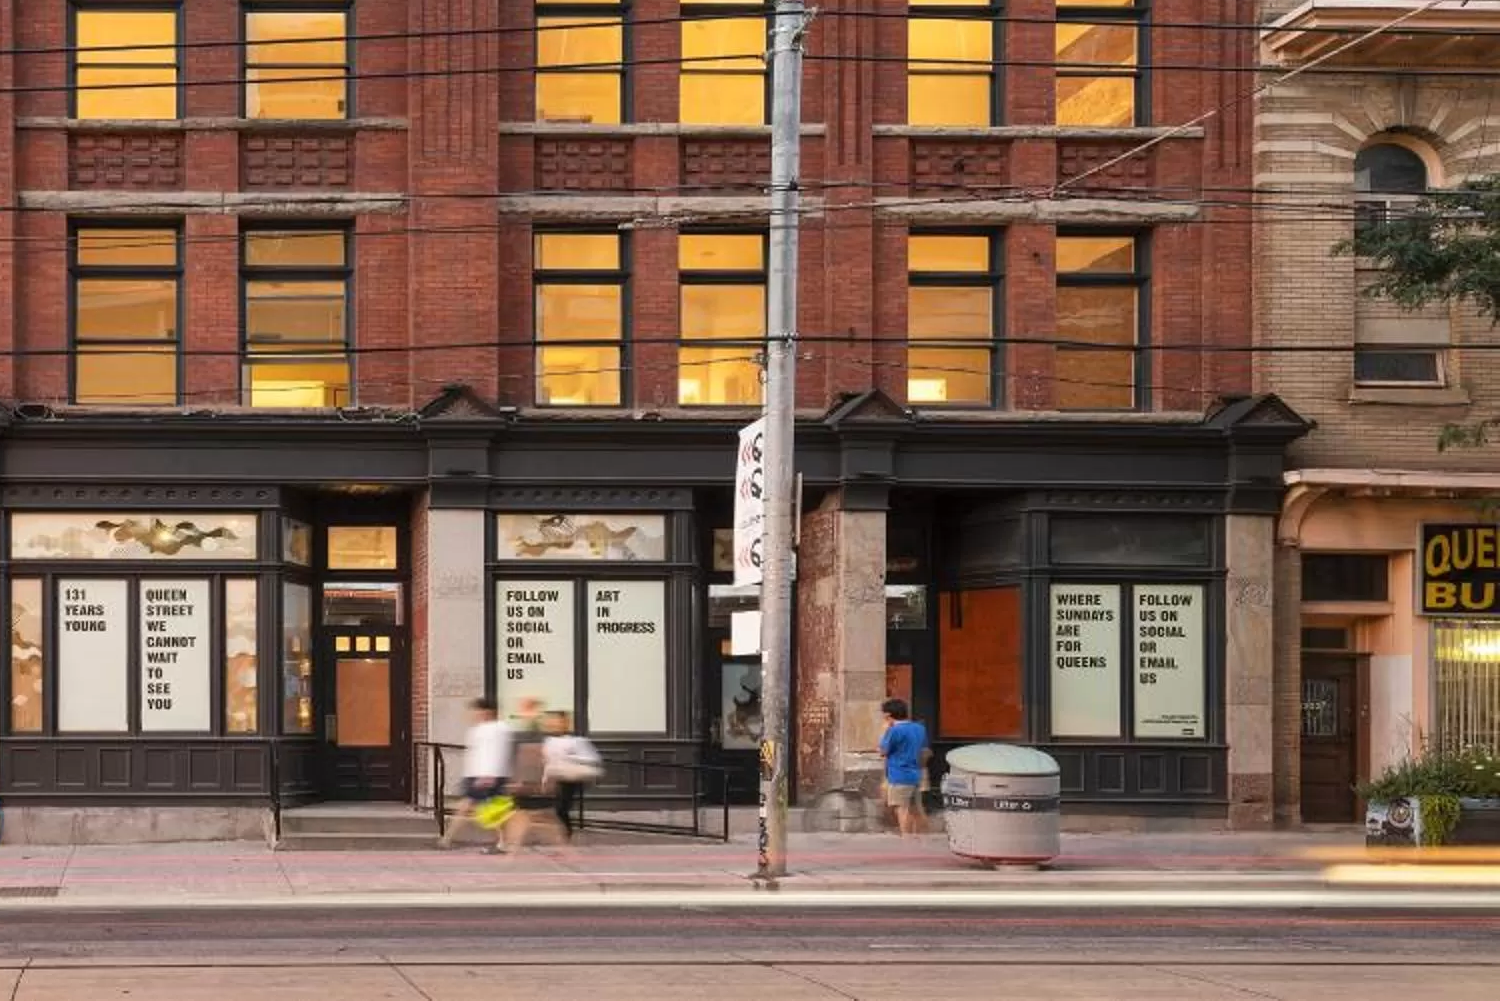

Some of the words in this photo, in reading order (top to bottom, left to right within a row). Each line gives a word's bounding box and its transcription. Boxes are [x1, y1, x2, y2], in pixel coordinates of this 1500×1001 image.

[65, 588, 86, 601] 131
[146, 588, 187, 602] QUEEN
[506, 590, 559, 602] FOLLOW
[596, 590, 620, 602] ART
[1056, 594, 1102, 606] WHERE
[1139, 594, 1192, 606] FOLLOW
[65, 605, 105, 616] YEARS
[146, 605, 194, 616] STREET
[506, 606, 523, 618] US
[528, 606, 545, 618] ON
[597, 606, 610, 618] IN
[1056, 610, 1114, 621] SUNDAYS
[1139, 610, 1156, 622] US
[1161, 610, 1178, 622] ON
[65, 620, 106, 632] YOUNG
[146, 620, 167, 632] WE
[506, 622, 552, 634] SOCIAL
[597, 622, 655, 634] PROGRESS
[1056, 625, 1080, 636] ARE
[1139, 626, 1186, 638] SOCIAL
[146, 636, 197, 648] CANNOT
[506, 637, 524, 649] OR
[1056, 640, 1081, 652] FOR
[1139, 641, 1157, 653] OR
[147, 652, 178, 664] WAIT
[507, 652, 545, 664] EMAIL
[1056, 656, 1107, 669] QUEENS
[1139, 657, 1178, 669] EMAIL
[147, 667, 163, 680] TO
[507, 668, 524, 680] US
[1139, 673, 1157, 684] US
[147, 683, 171, 695] SEE
[147, 699, 172, 710] YOU
